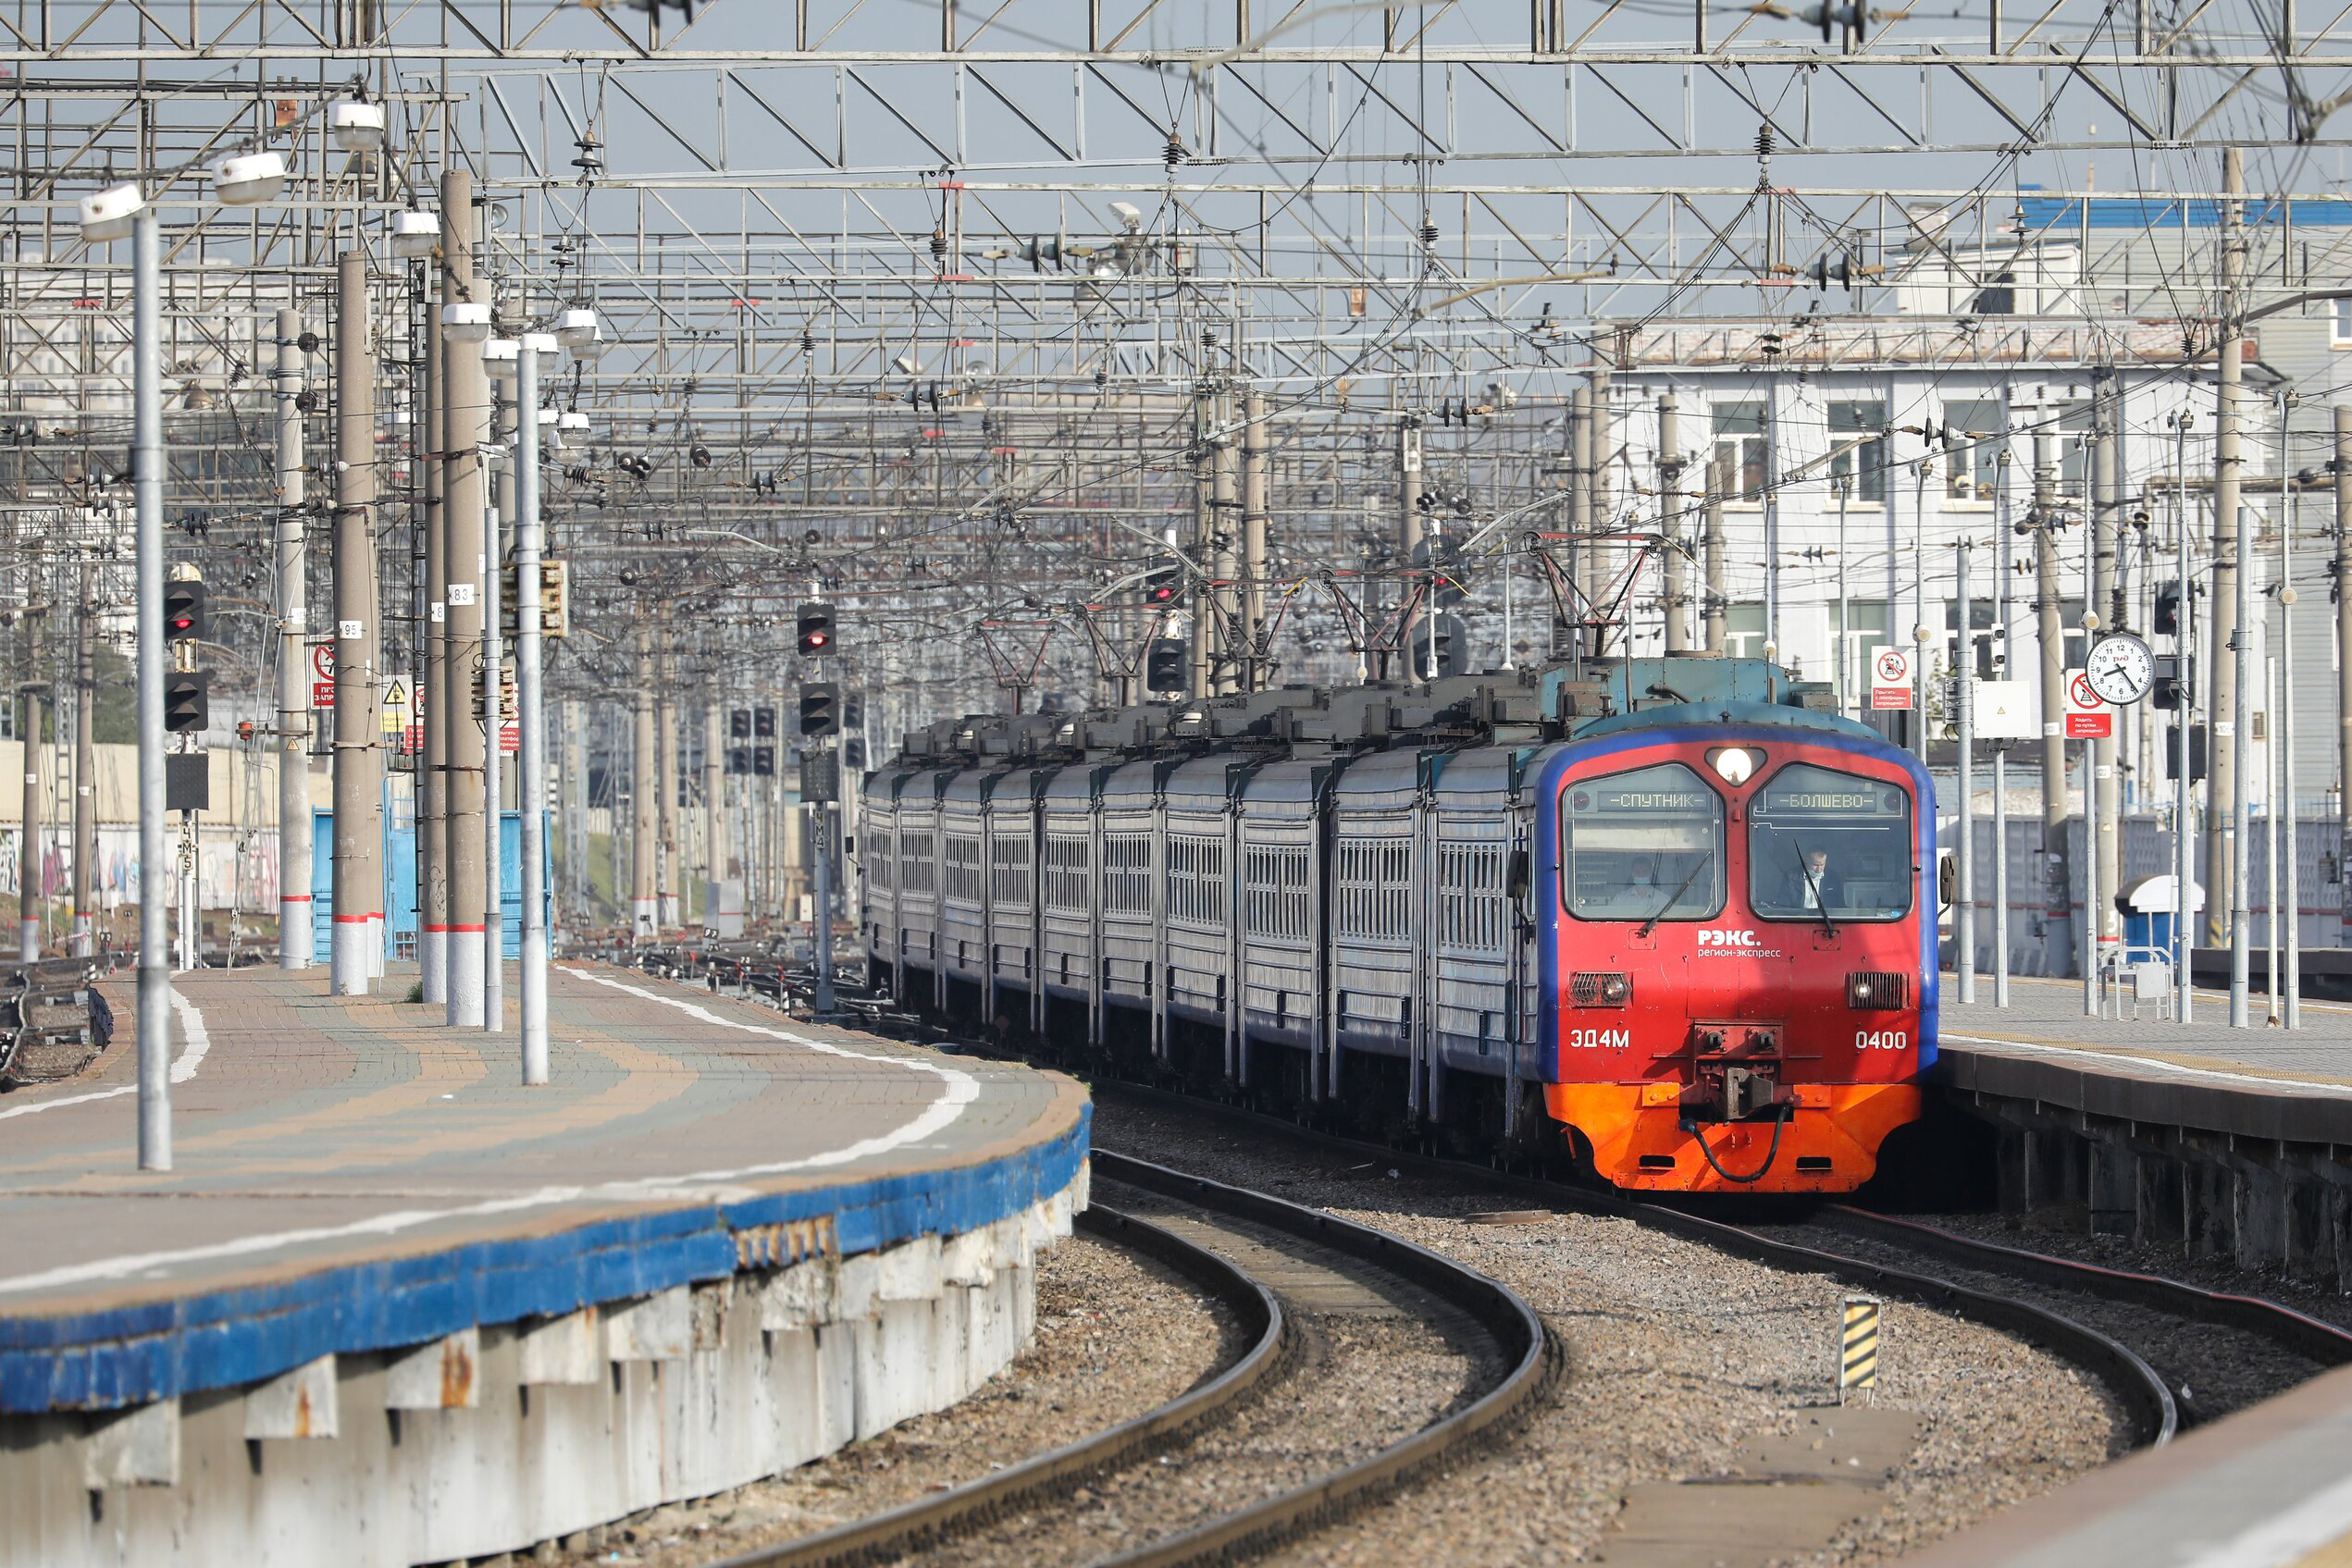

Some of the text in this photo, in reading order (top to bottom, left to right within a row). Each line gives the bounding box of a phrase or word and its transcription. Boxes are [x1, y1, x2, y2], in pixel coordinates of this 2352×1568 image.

[454, 588, 468, 601] 83
[344, 624, 357, 636] 95
[1697, 930, 1762, 946] РЭКС.
[1697, 948, 1781, 959] регион-экспресс
[1570, 1029, 1629, 1048] ЭД4М
[1855, 1031, 1907, 1050] 0400
